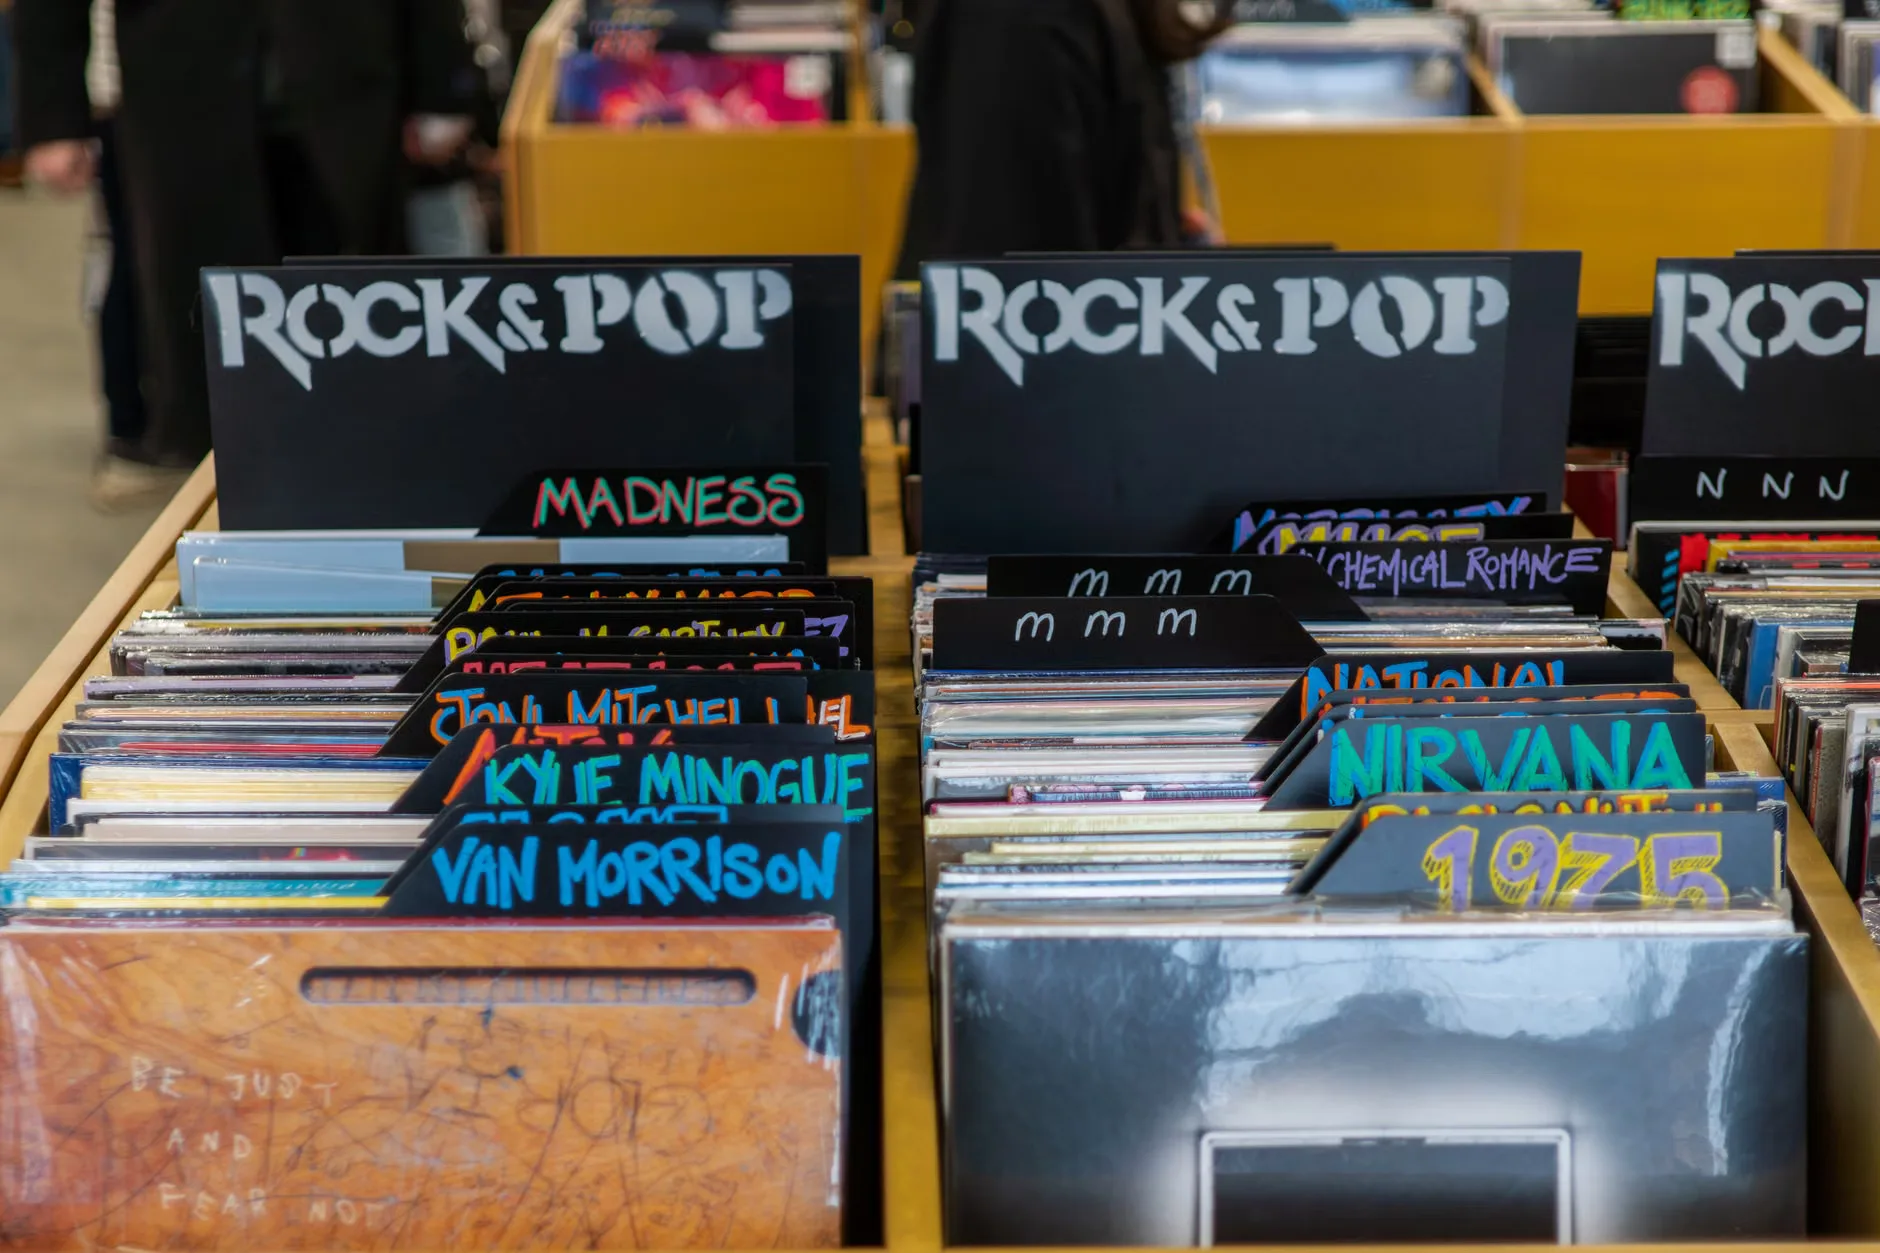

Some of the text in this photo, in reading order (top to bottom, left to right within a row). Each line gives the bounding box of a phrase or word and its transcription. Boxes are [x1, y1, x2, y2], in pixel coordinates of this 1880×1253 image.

[1656, 272, 1880, 392] ROC
[531, 472, 805, 530] MADNESS
[1465, 543, 1604, 592] ROMANCE
[1327, 719, 1694, 806] NIRVANA
[430, 830, 842, 909] VAN MORRISON
[1420, 823, 1730, 911] 1975
